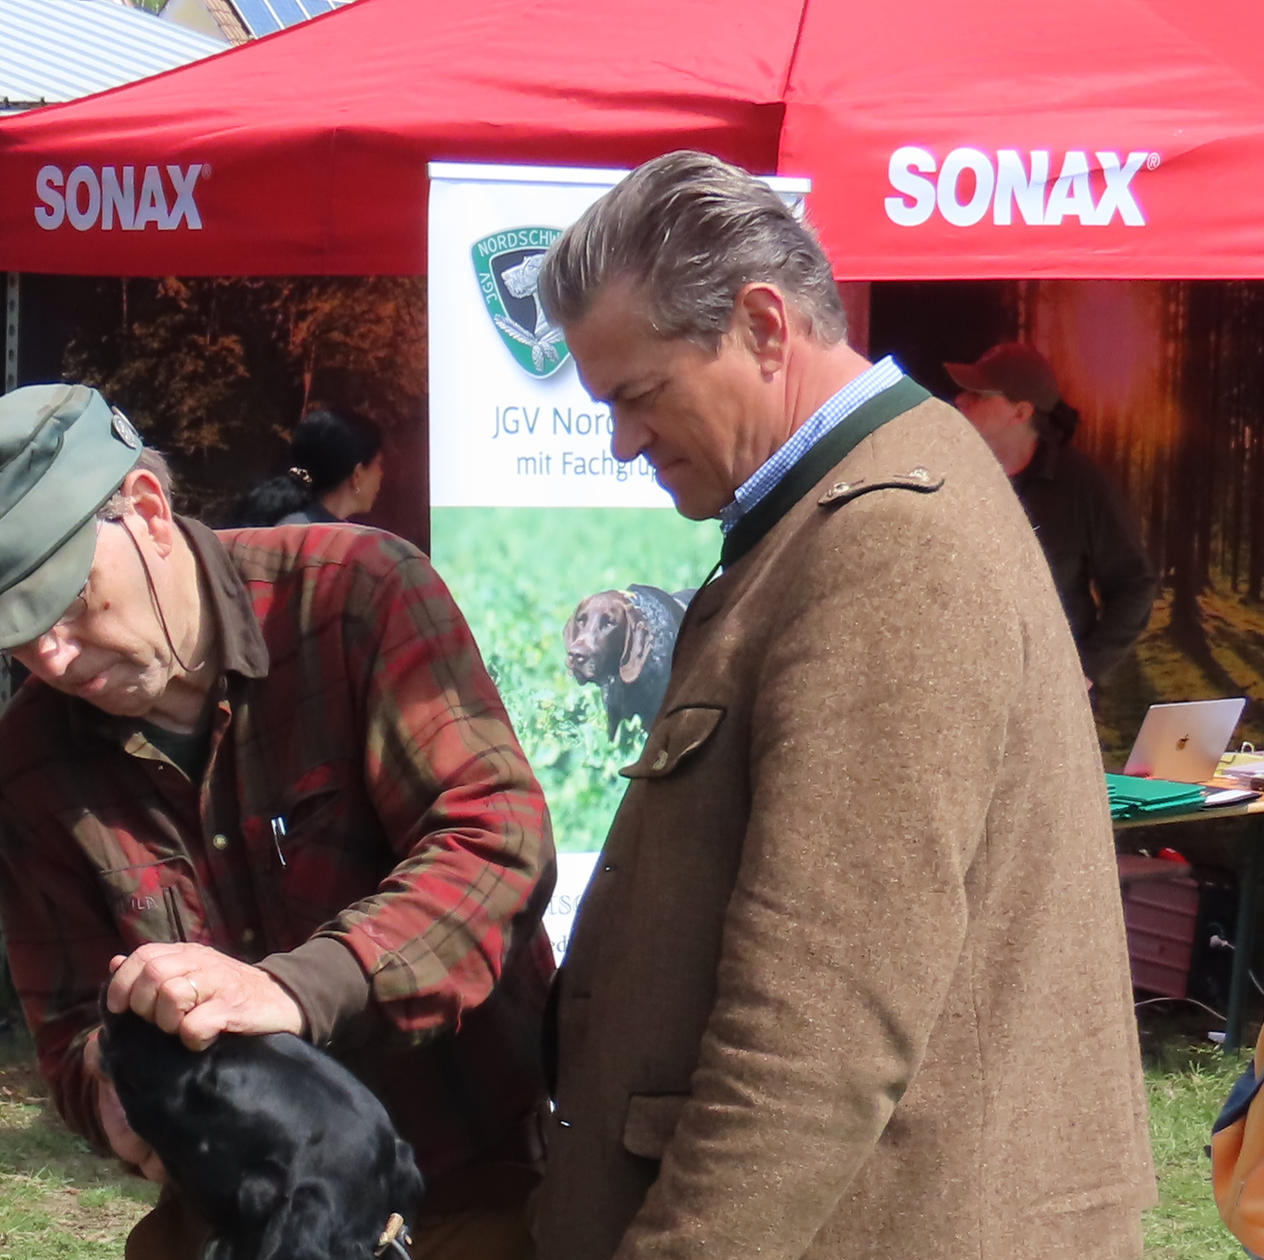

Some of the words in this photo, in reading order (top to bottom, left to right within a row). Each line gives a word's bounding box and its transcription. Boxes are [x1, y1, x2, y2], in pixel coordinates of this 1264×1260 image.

[479, 272, 498, 304] JGV
[492, 406, 540, 439] JGV
[517, 451, 552, 475] mit
